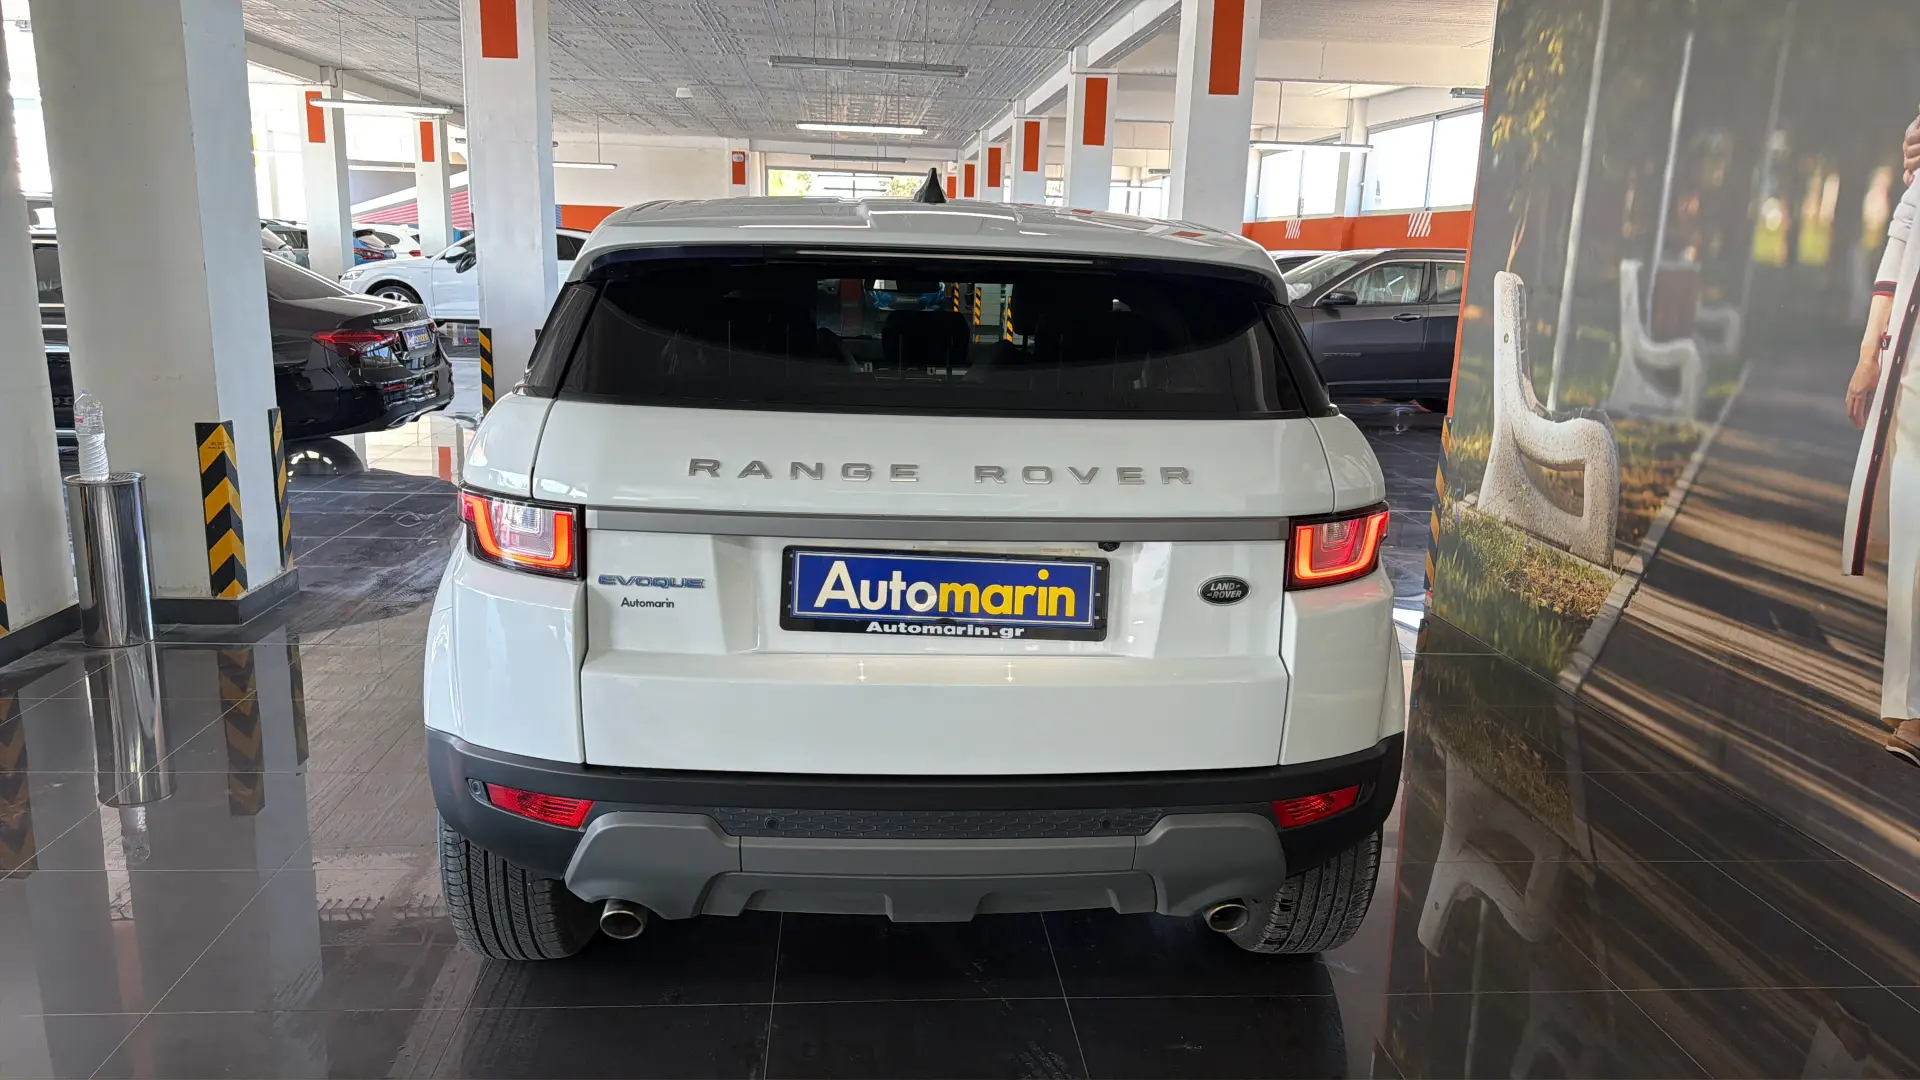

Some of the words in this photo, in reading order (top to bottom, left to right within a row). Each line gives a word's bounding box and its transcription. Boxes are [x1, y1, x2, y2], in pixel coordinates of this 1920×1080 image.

[688, 458, 919, 482] RANGE
[974, 465, 1192, 485] ROVER
[598, 574, 706, 589] EVOQUE
[813, 561, 1076, 617] Automarin
[1210, 582, 1236, 590] LAND
[1211, 590, 1242, 598] ROVER
[621, 597, 675, 608] Automarin
[866, 621, 1025, 639] Automarin.gr
